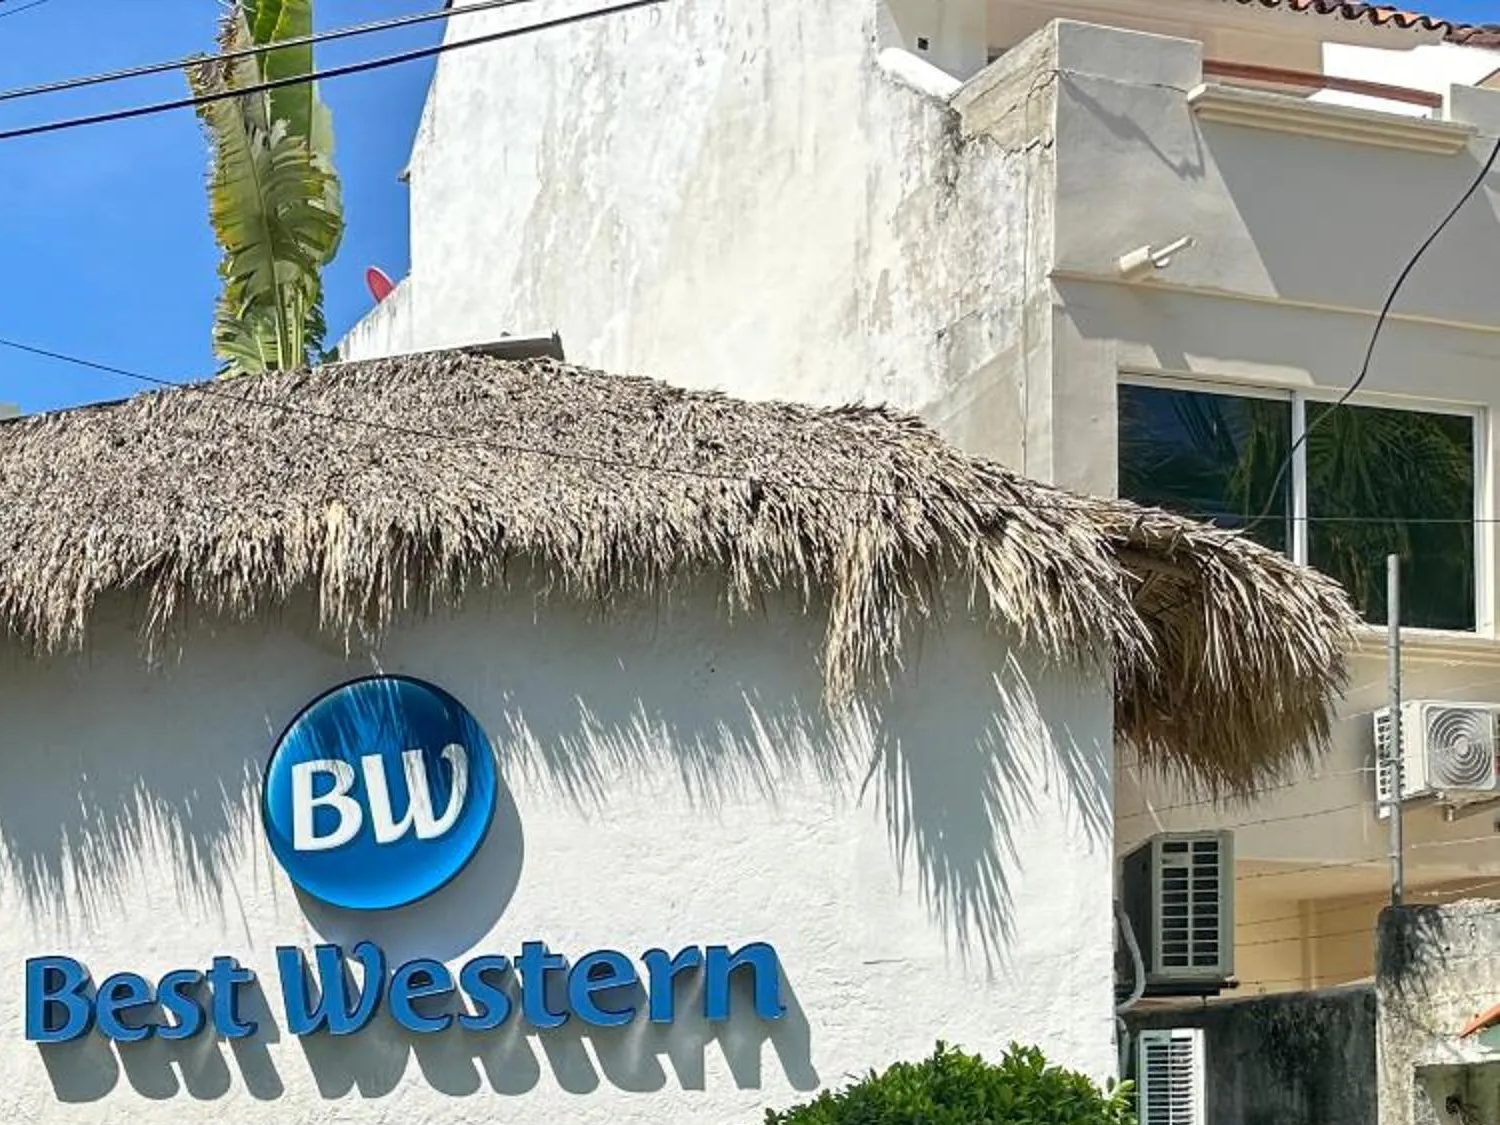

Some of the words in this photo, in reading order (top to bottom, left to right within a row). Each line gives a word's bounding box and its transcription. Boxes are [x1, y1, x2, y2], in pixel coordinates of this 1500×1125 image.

[291, 742, 470, 852] BW
[25, 955, 257, 1044] Best
[275, 940, 787, 1037] Western
